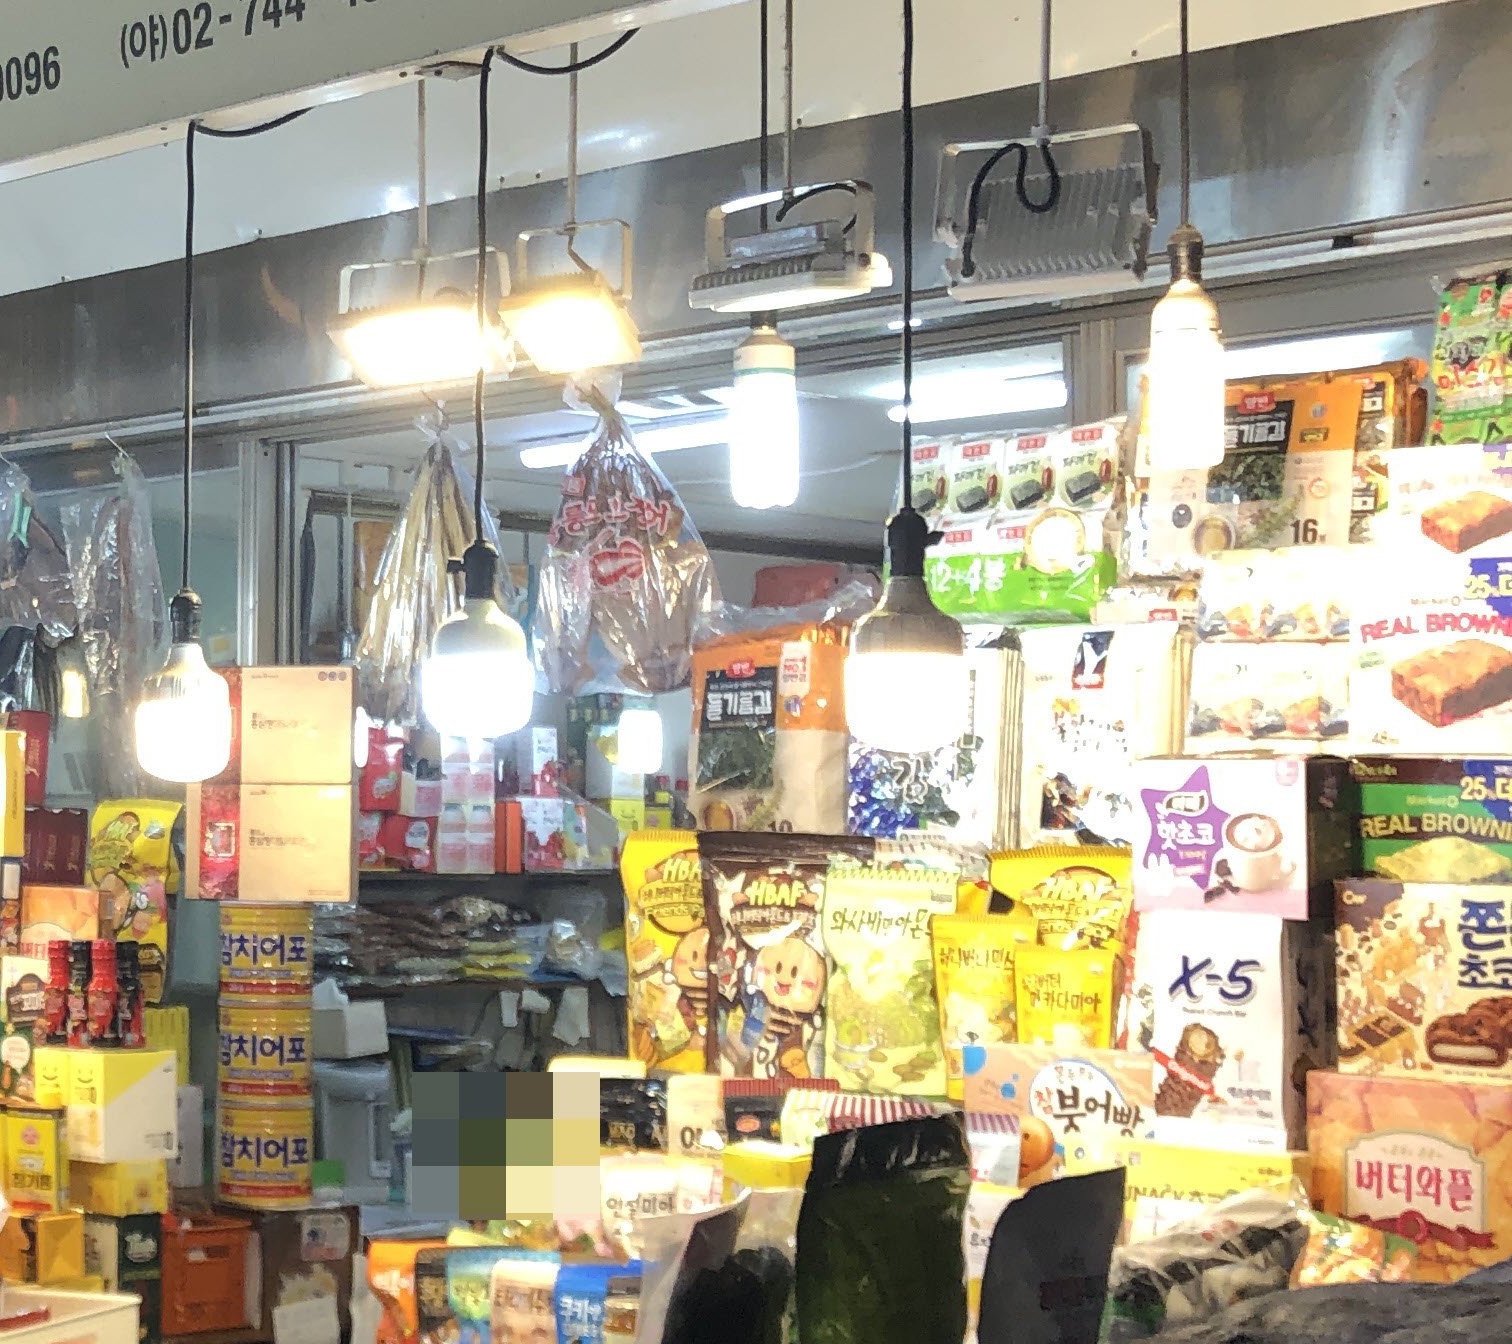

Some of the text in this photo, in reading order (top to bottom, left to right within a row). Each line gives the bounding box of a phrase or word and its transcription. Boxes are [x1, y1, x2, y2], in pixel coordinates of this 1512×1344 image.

[1360, 612, 1512, 644] REAL BROWN
[1358, 813, 1418, 839] REAL
[662, 858, 703, 883] HBA
[746, 880, 807, 908] HBAF
[1168, 954, 1263, 1006] X-5
